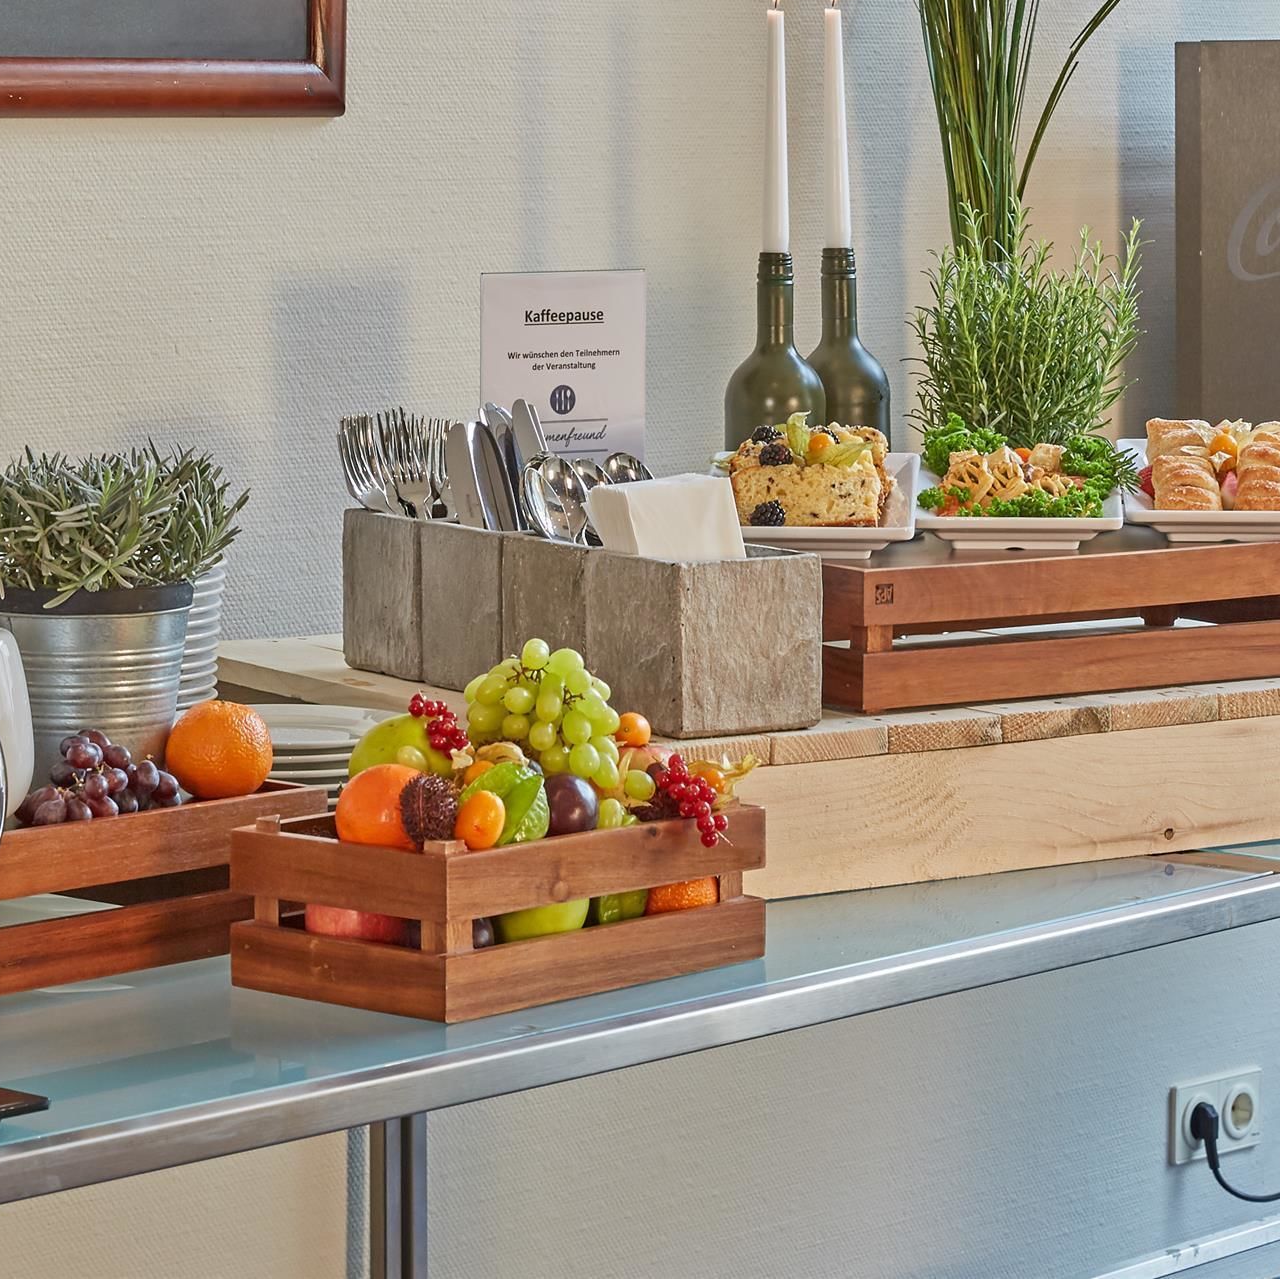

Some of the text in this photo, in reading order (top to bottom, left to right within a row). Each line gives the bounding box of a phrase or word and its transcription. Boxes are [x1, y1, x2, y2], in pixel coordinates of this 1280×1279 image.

[524, 308, 604, 324] Kaffeepause
[507, 348, 620, 360] Wir wünschen den Teilnehmern
[532, 361, 596, 371] der Veranstaltung
[544, 424, 607, 448] menfreund
